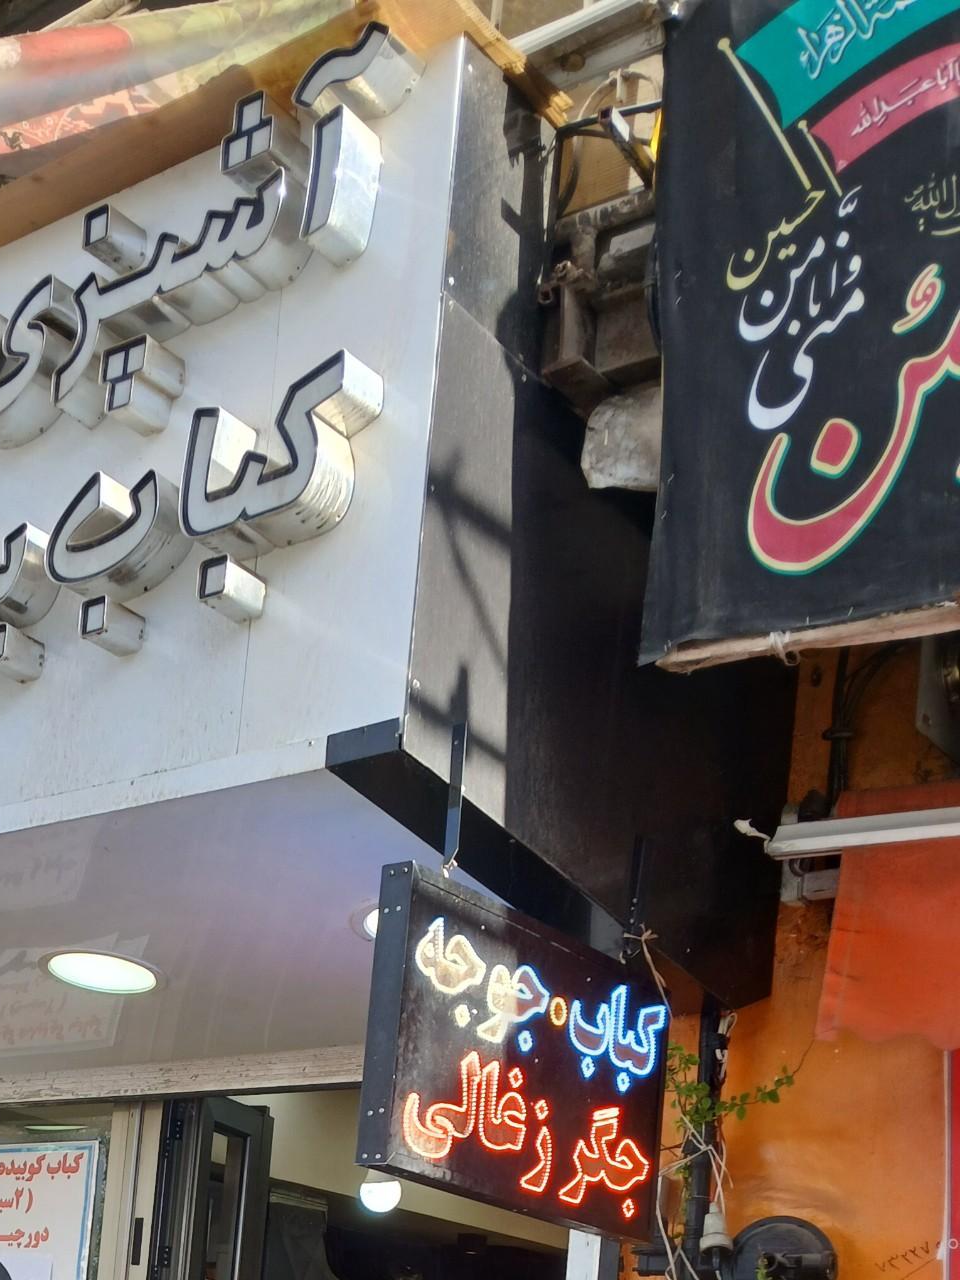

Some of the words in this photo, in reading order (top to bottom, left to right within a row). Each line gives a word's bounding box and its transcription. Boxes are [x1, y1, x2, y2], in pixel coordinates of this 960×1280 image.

[726, 189, 826, 291] حسین
[45, 349, 365, 645] کباب
[415, 916, 550, 1051] جوجه
[569, 985, 668, 1093] کباب
[47, 1152, 84, 1180] کباب
[402, 1050, 553, 1192] زغالی
[558, 1106, 650, 1218] جگر
